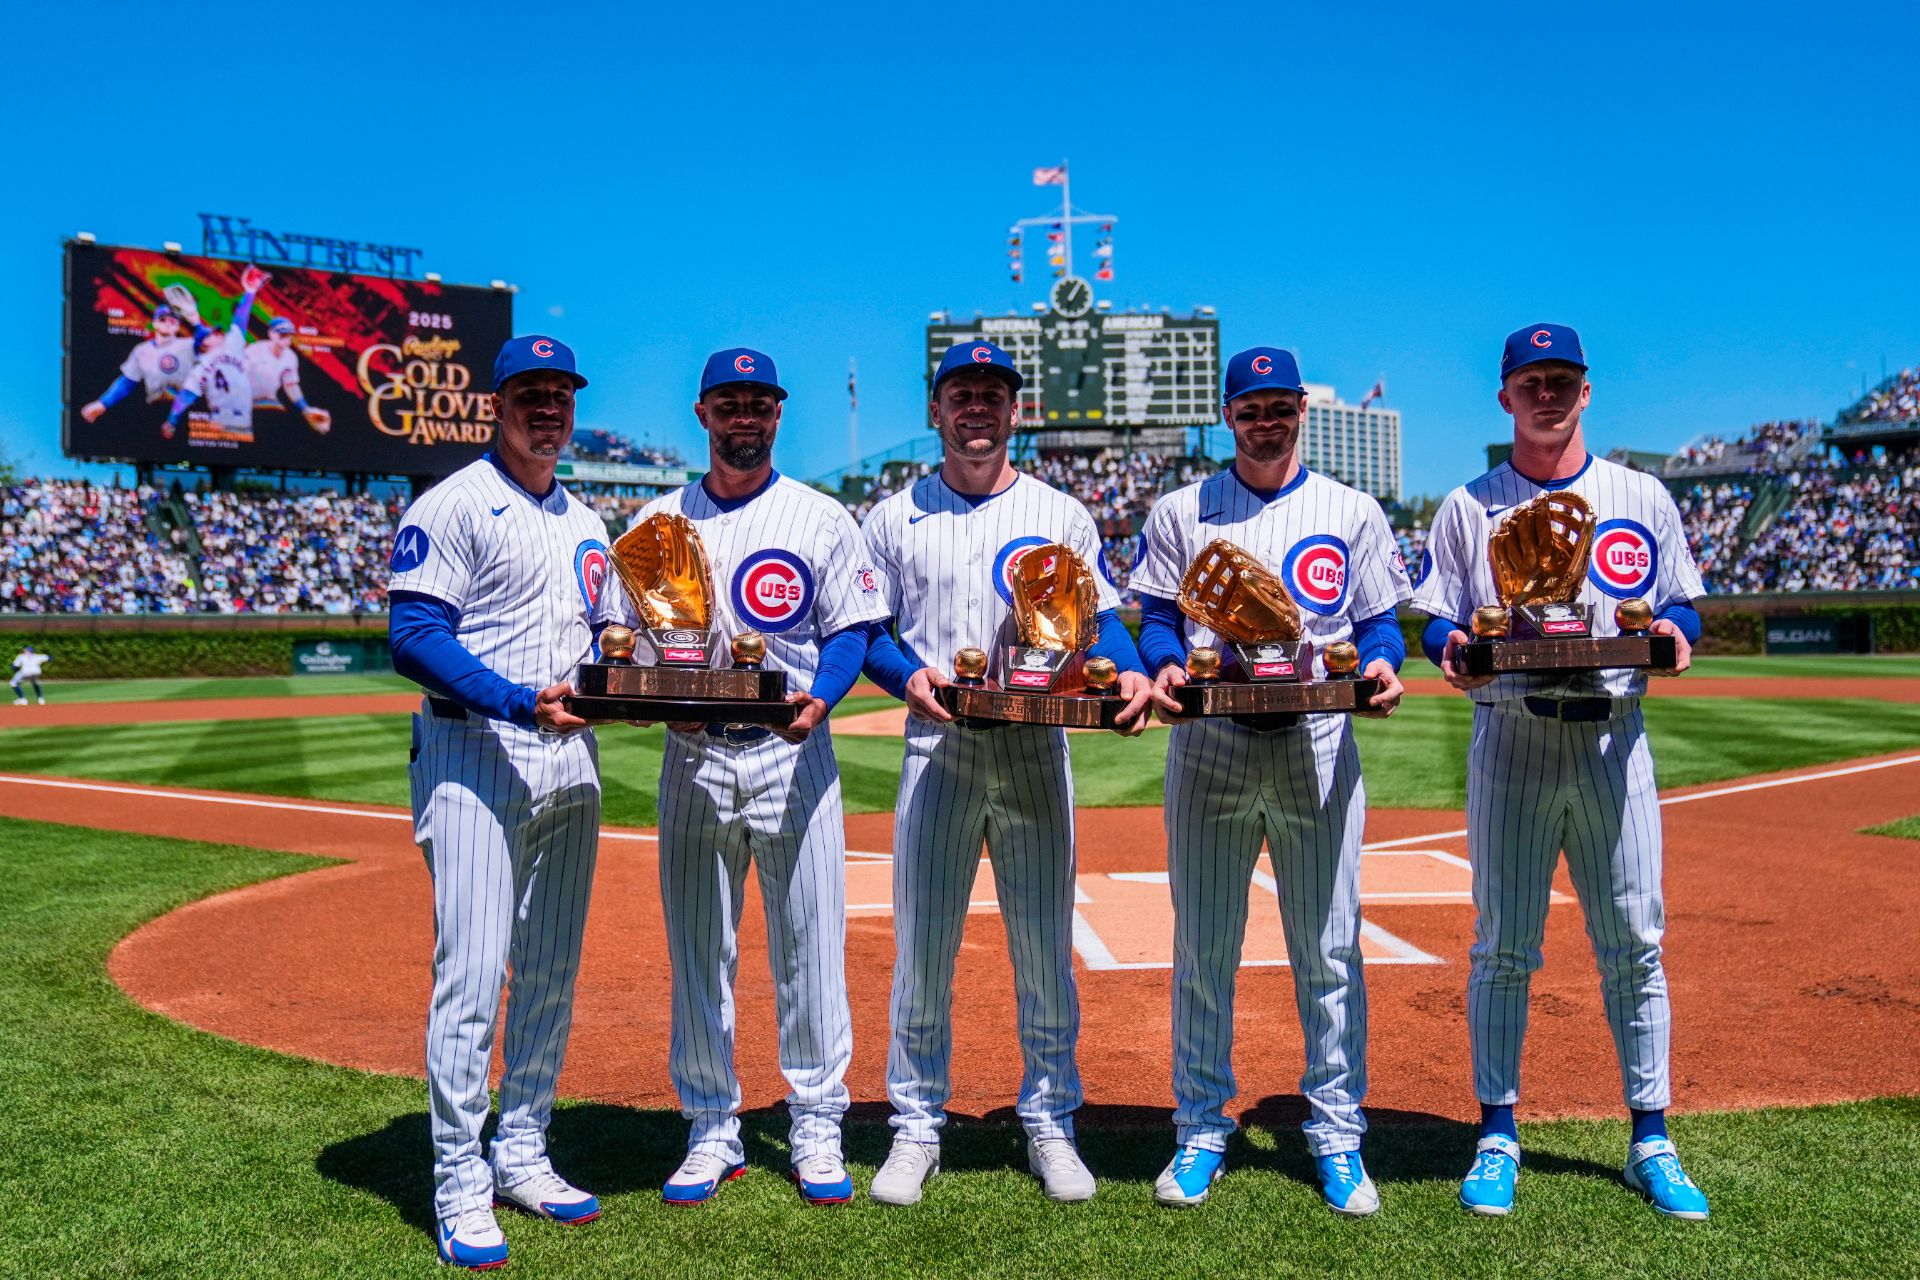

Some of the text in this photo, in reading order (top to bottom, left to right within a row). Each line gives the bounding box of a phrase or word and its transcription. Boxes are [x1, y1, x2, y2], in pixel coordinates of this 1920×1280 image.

[197, 213, 423, 277] WINTRUST
[408, 311, 453, 329] 2025
[1530, 329, 1552, 348] C
[532, 340, 554, 357] C
[972, 347, 992, 363] C
[357, 344, 470, 399] GOLD
[734, 355, 755, 373] C
[1251, 355, 1272, 375] C
[408, 417, 493, 445] AWARD
[1766, 629, 1831, 643] SLOAN
[299, 653, 352, 667] Gallagher
